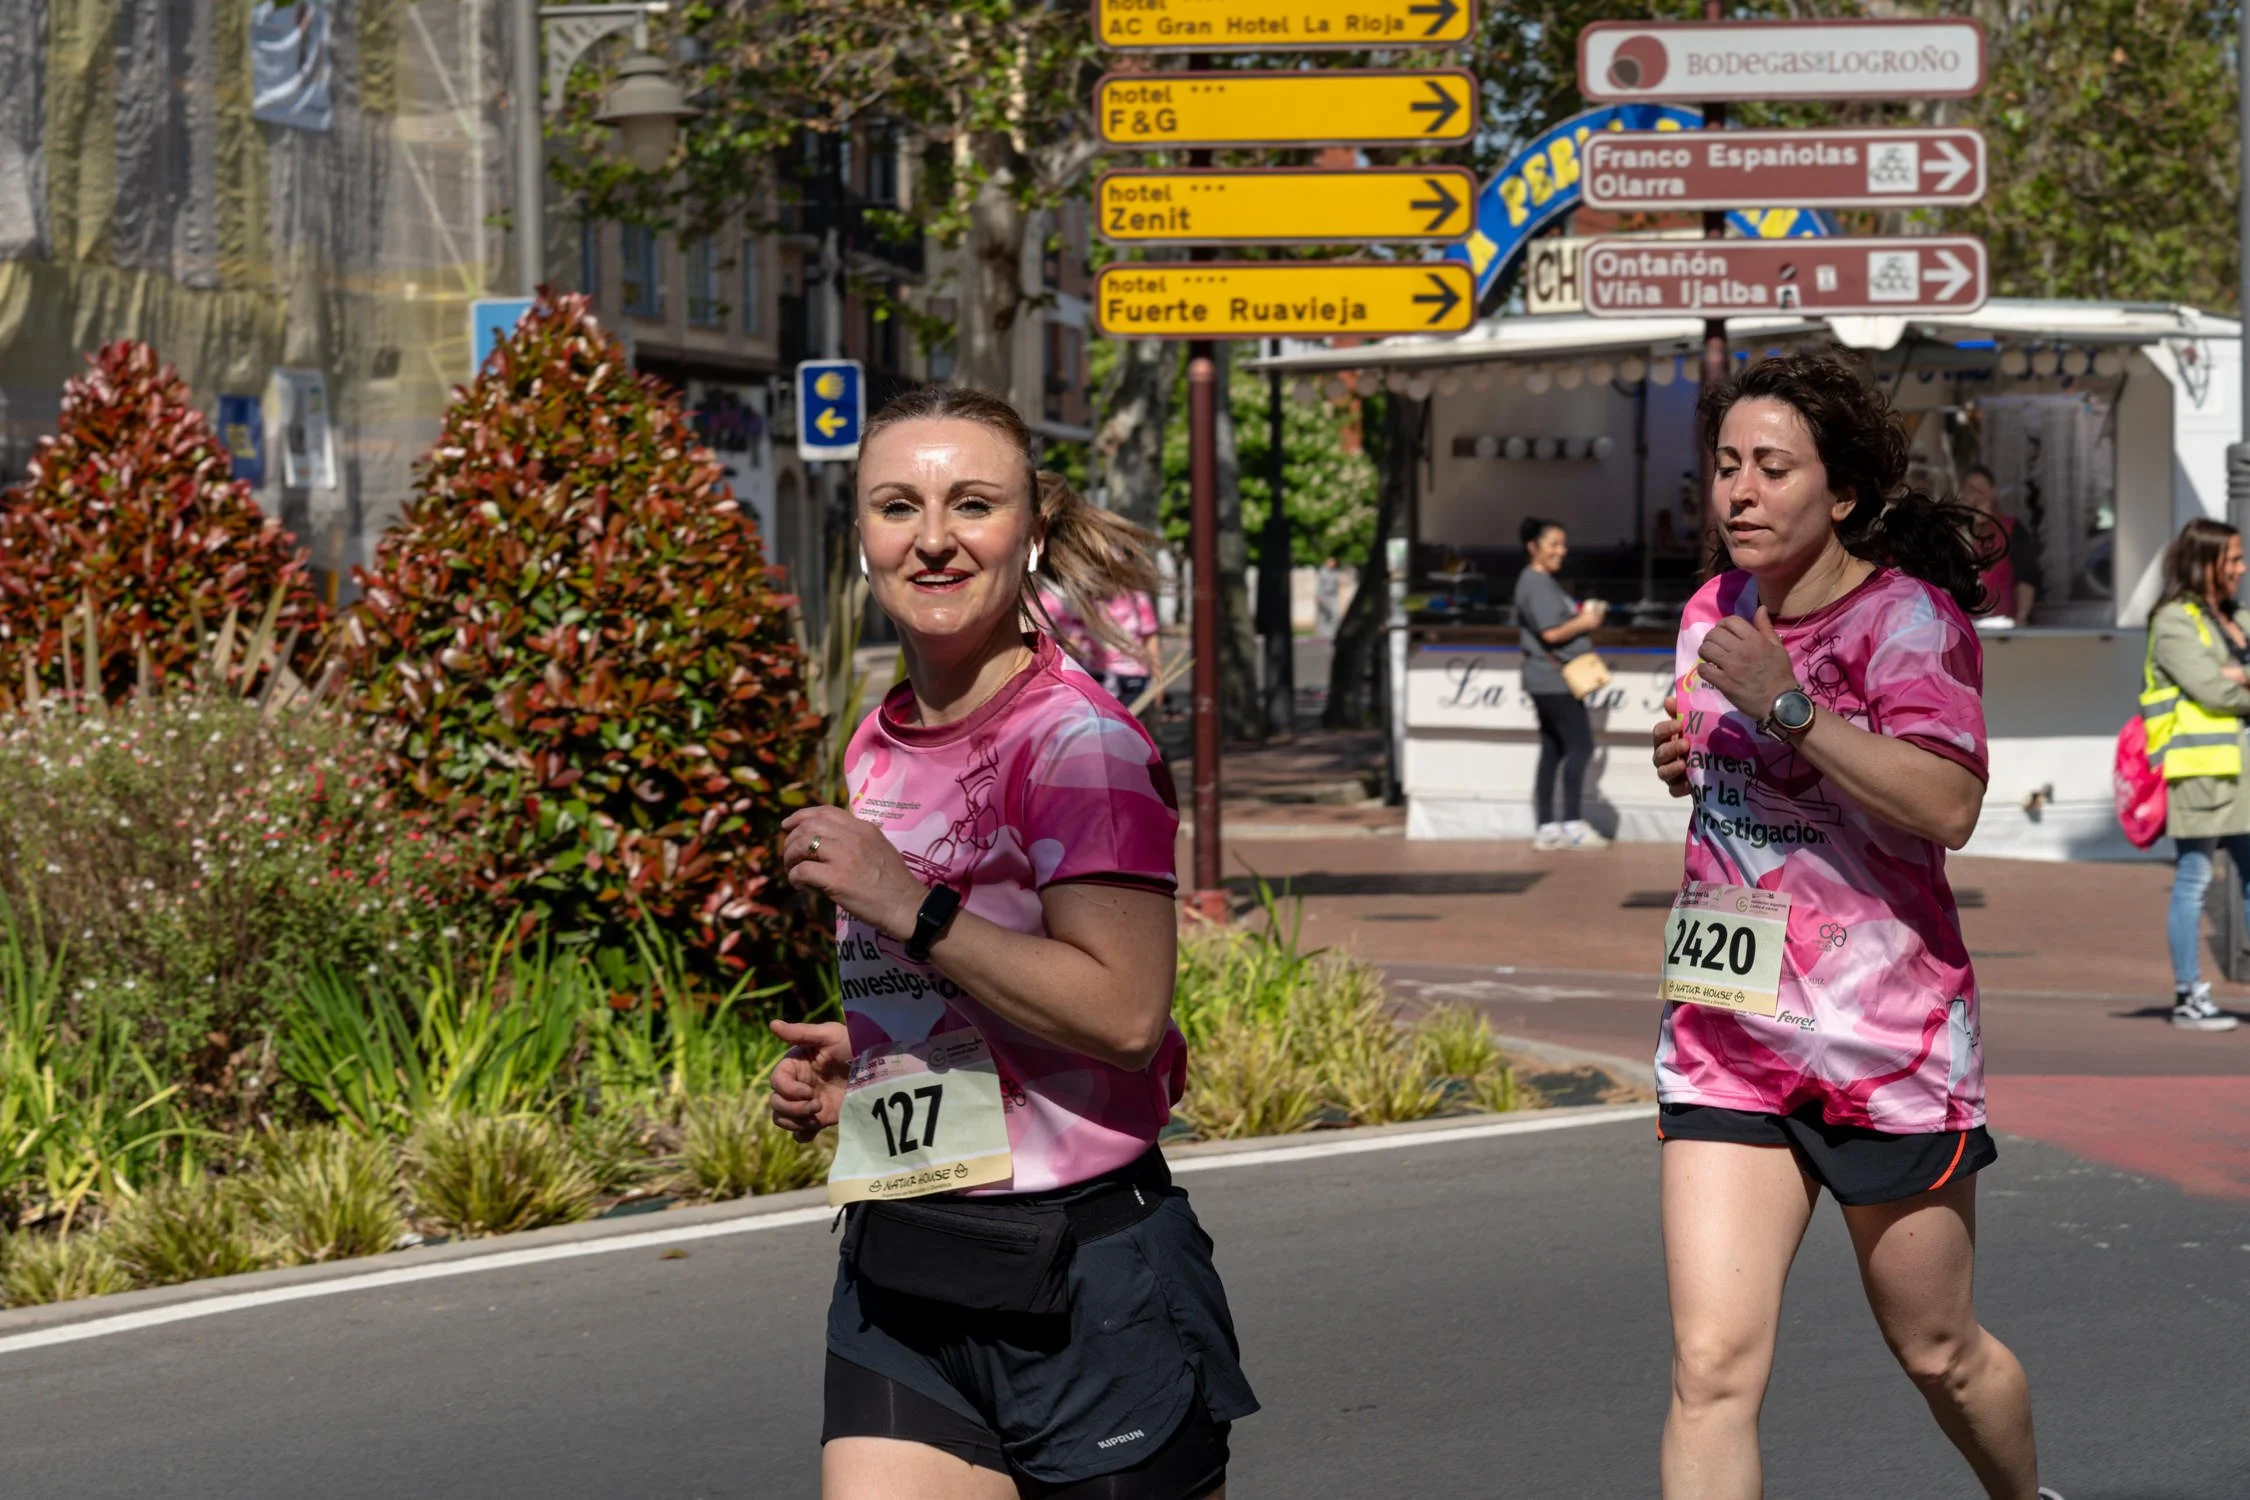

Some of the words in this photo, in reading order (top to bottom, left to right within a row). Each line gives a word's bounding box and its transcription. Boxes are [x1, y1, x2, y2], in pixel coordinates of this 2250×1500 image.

[1109, 17, 1142, 36] AC
[1157, 17, 1212, 35] Gran
[1226, 15, 1289, 34] Hotel
[1305, 15, 1330, 33] La
[1346, 14, 1404, 35] Rioja
[1827, 44, 1961, 73] LOGROÑO
[1109, 85, 1173, 104] hotel
[1594, 144, 1692, 169] Franco
[1708, 141, 1858, 172] Españolas
[1109, 184, 1173, 202] hotel
[1594, 173, 1686, 198] Olarra
[1109, 207, 1191, 231] Zenit
[1594, 251, 1727, 277] Ontañón
[1107, 276, 1167, 293] hotel
[1594, 278, 1661, 305] Viña
[1680, 278, 1768, 309] Ijalba
[1108, 299, 1208, 323] Fuerte
[1230, 297, 1367, 326] Ruavieja
[1438, 656, 1504, 710] La
[1685, 711, 1704, 735] XI
[1718, 779, 1740, 806] la
[856, 931, 881, 960] la
[1668, 918, 1756, 975] 2420
[1674, 984, 1701, 996] NATUR
[1703, 987, 1732, 1001] HOUSE
[872, 1084, 943, 1157] 127
[883, 1175, 917, 1191] NATUR
[918, 1168, 952, 1185] HOUSE
[1096, 1429, 1145, 1449] KIPRUN
